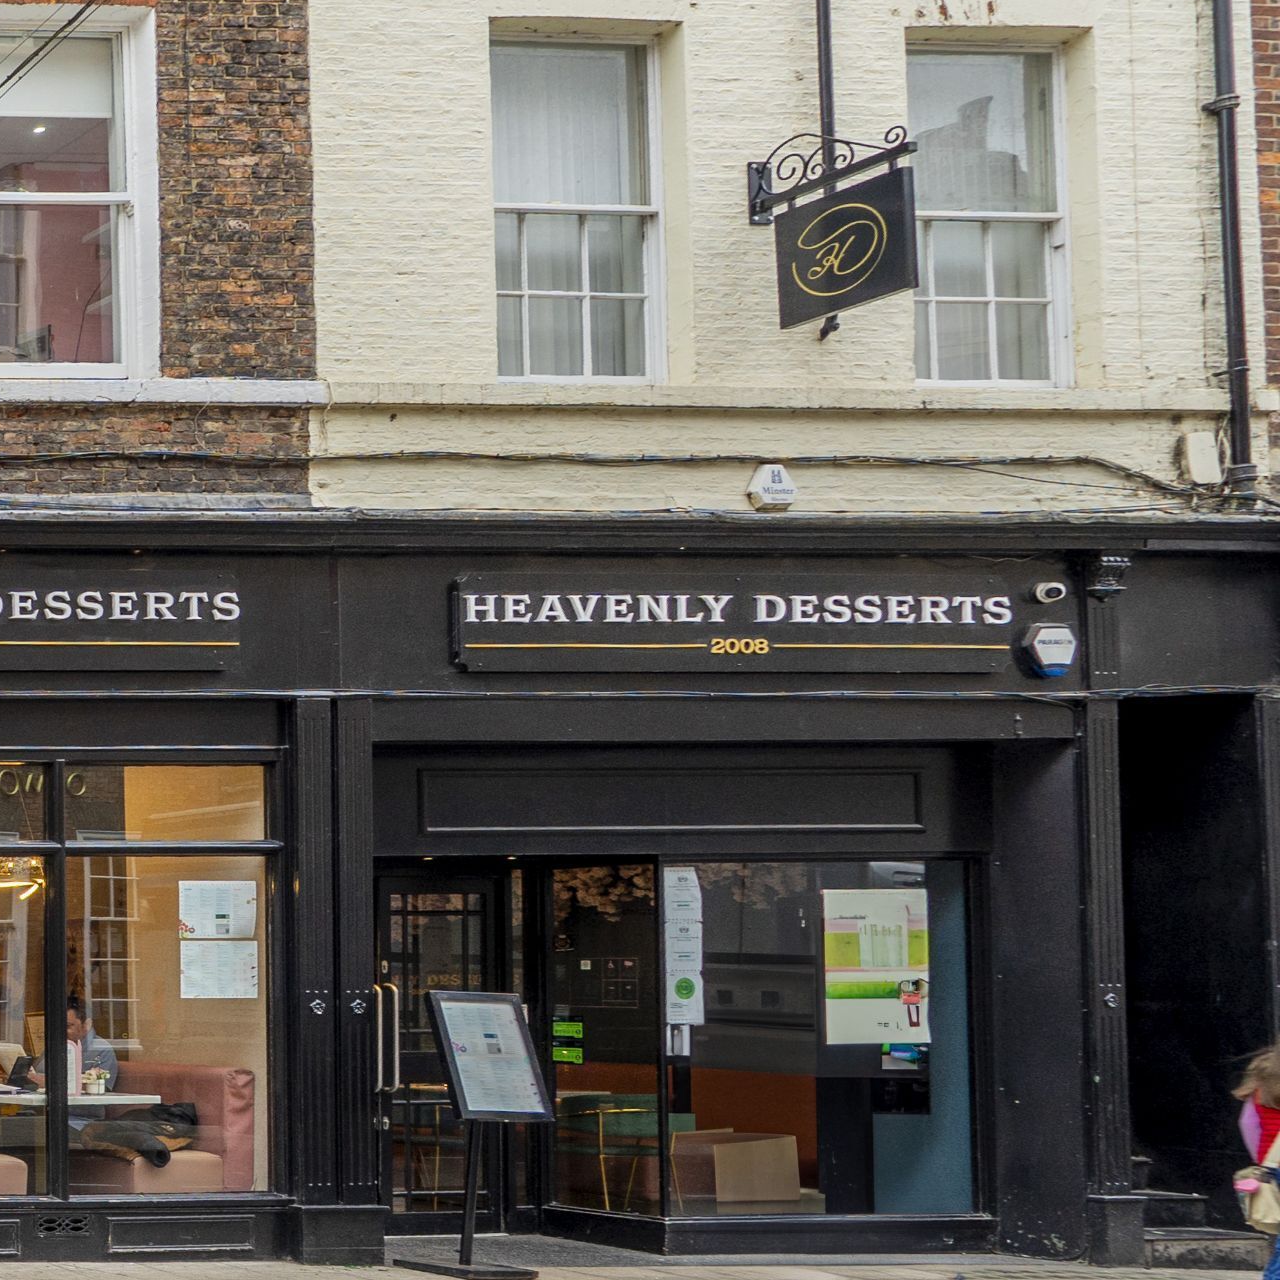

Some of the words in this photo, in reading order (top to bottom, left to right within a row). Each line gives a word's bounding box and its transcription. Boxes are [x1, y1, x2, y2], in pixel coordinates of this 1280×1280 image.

[463, 594, 733, 624] HEAVENLY
[753, 595, 1014, 625] DESSERTS
[709, 637, 770, 655] 2008
